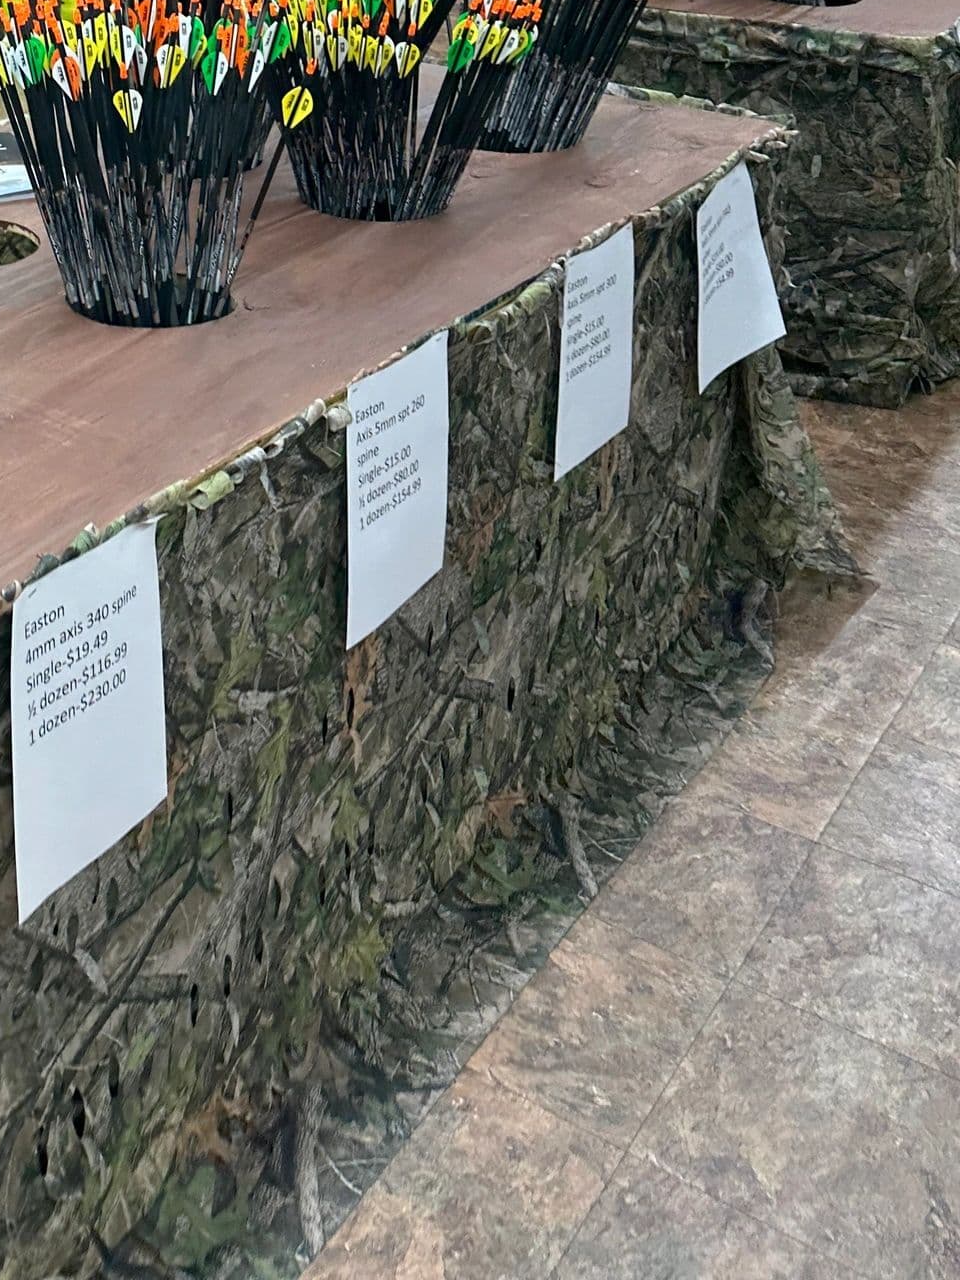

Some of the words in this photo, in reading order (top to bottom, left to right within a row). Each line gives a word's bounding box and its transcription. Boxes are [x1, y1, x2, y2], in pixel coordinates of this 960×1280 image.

[355, 400, 385, 424] Easton
[356, 426, 373, 446] Axis
[375, 414, 397, 436] 5mm
[398, 405, 410, 423] spt
[411, 394, 425, 414] 260
[357, 445, 379, 467] spine
[358, 444, 412, 489] Single-$15.00
[24, 604, 65, 640] Easton
[25, 639, 56, 665] 4mm
[59, 620, 83, 644] axis
[86, 603, 109, 630] 340
[111, 584, 137, 615] spine
[26, 629, 108, 694] Single-$19.49
[40, 641, 128, 711] dozen-$116.99
[29, 729, 35, 746] 1
[38, 668, 127, 739] dozen-$230.00
